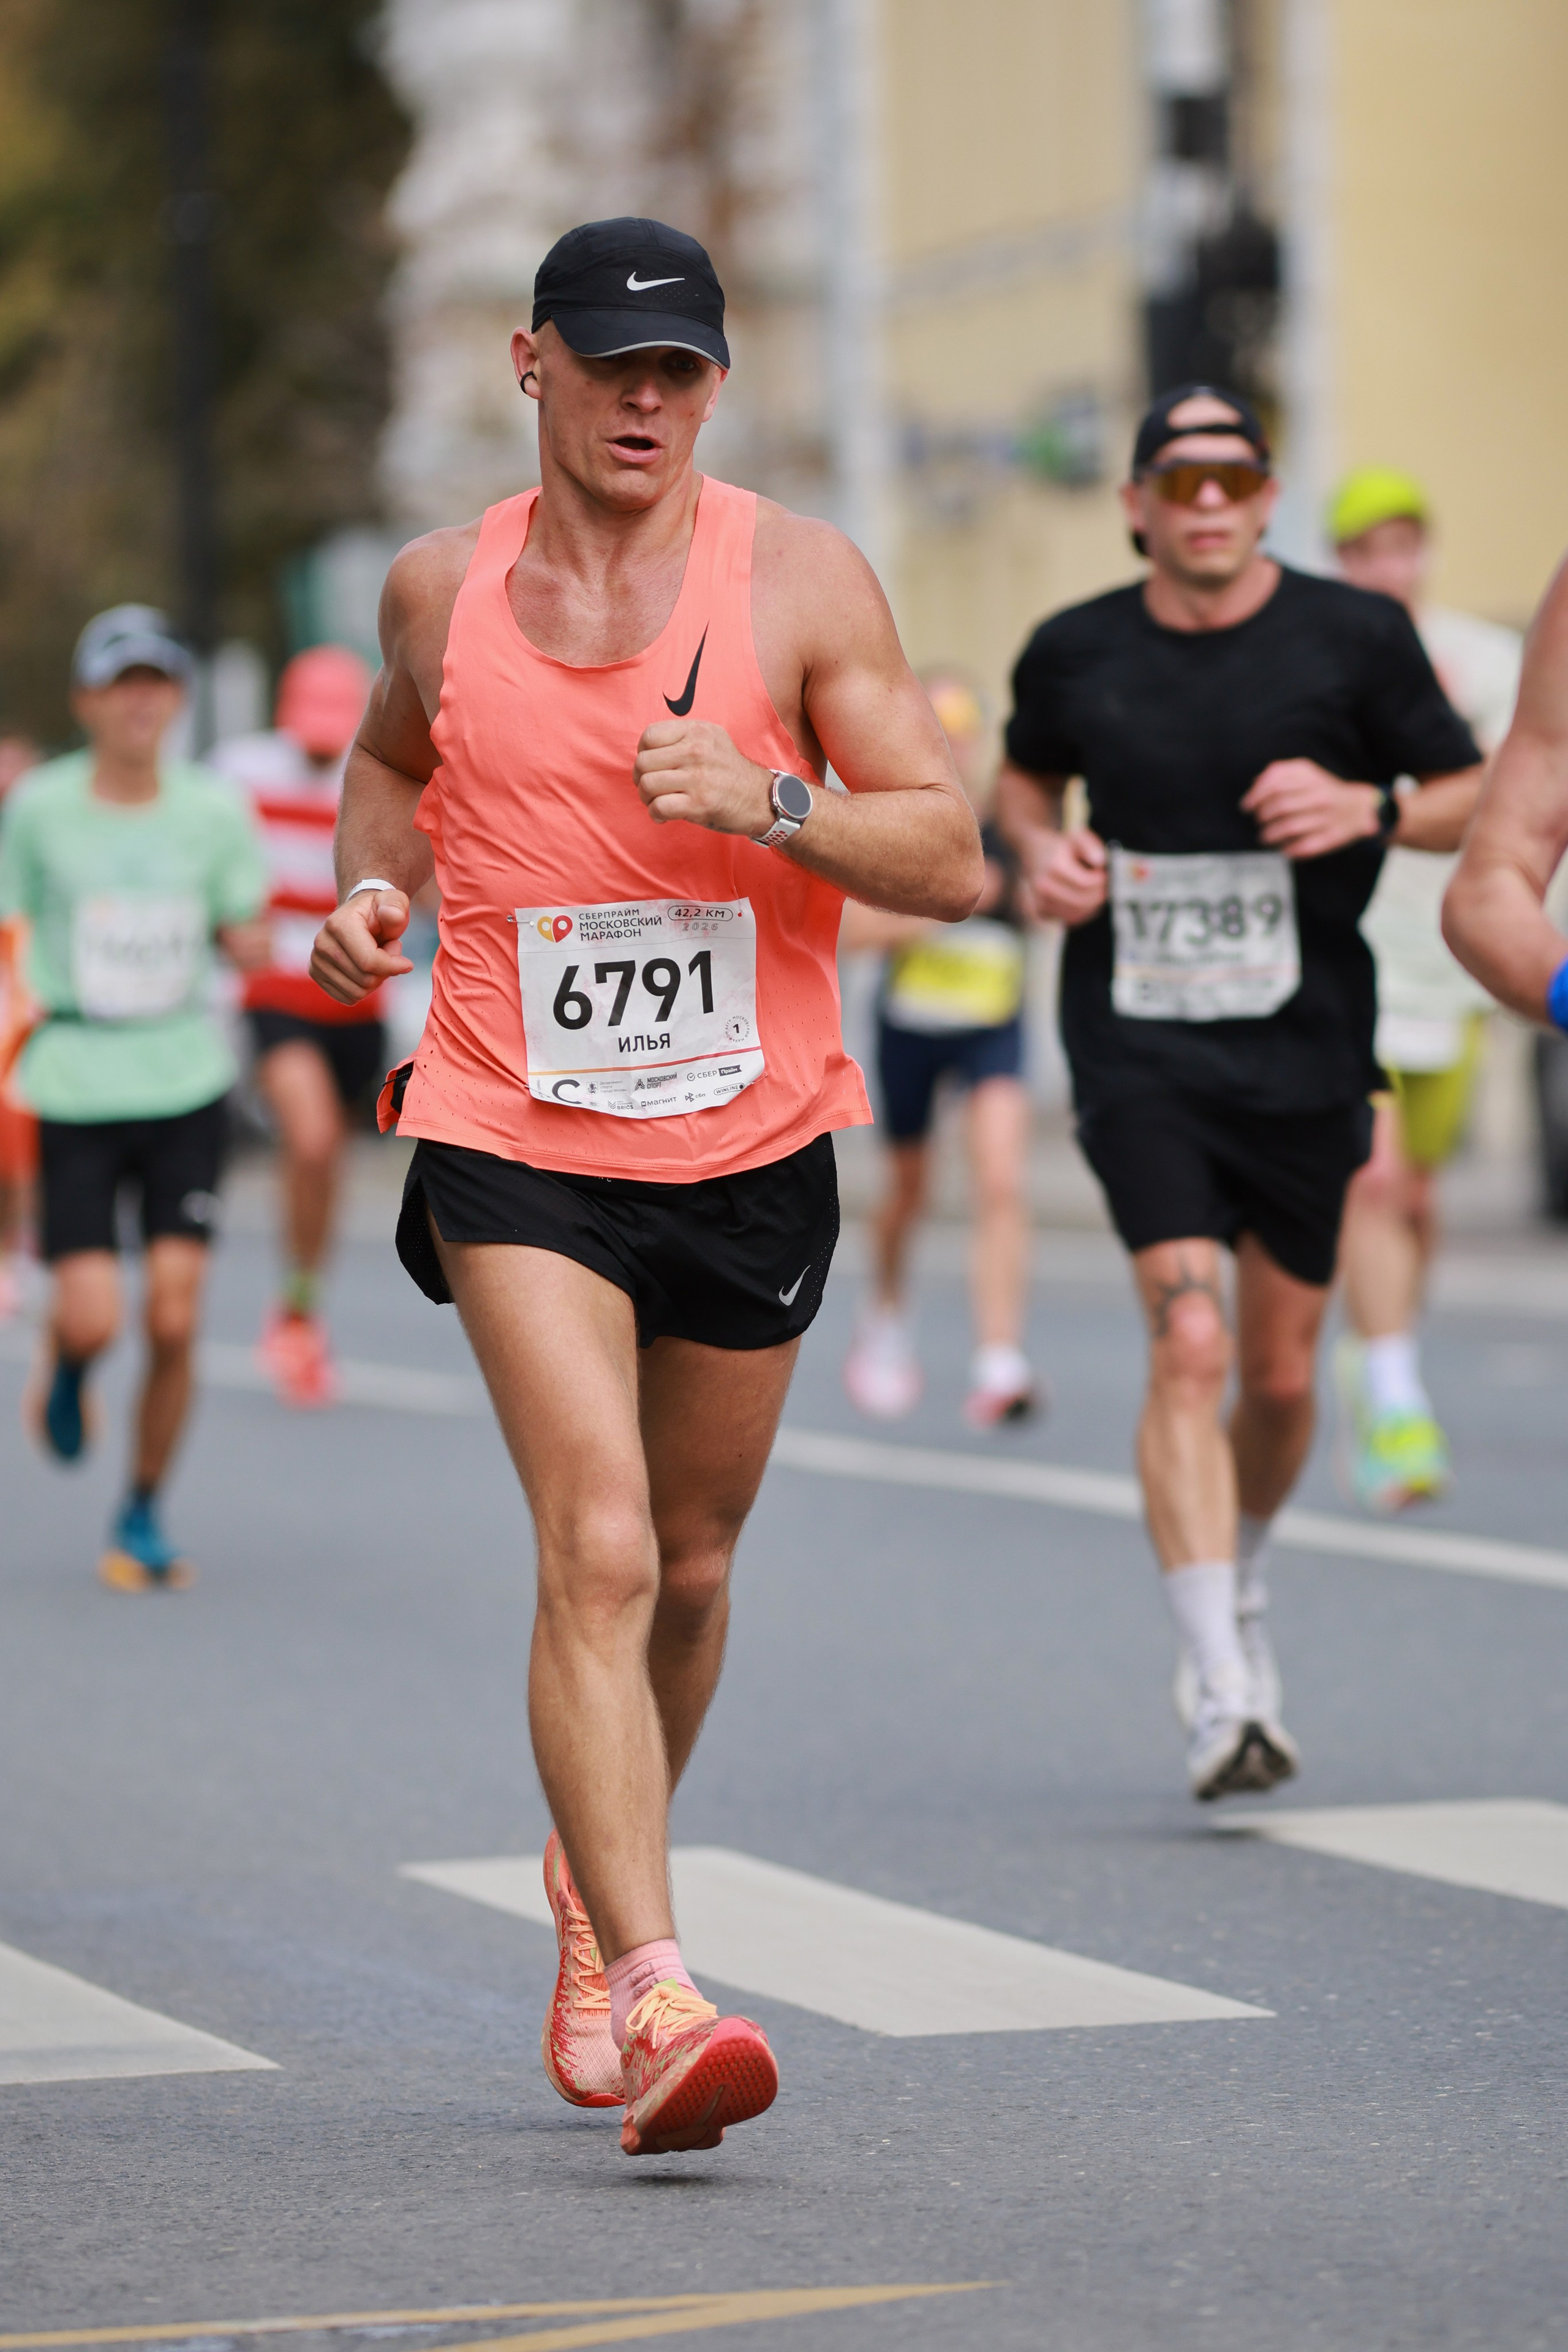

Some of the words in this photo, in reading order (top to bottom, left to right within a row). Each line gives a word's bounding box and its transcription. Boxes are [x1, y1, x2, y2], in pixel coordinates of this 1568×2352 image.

[579, 908, 639, 920] СБЕРПРАЙМ
[674, 908, 701, 918] 42,2
[1125, 892, 1284, 946] 17389
[579, 915, 662, 930] МОСКОВСКИЙ
[682, 922, 718, 931] 2026
[580, 929, 641, 941] МАРАФОН
[553, 950, 714, 1030] 6791
[733, 1023, 740, 1034] 1
[618, 1033, 671, 1053] ИЛЬЯ
[647, 1072, 677, 1083] МОСКОВСКИЙ
[716, 1085, 739, 1094] WINLINE
